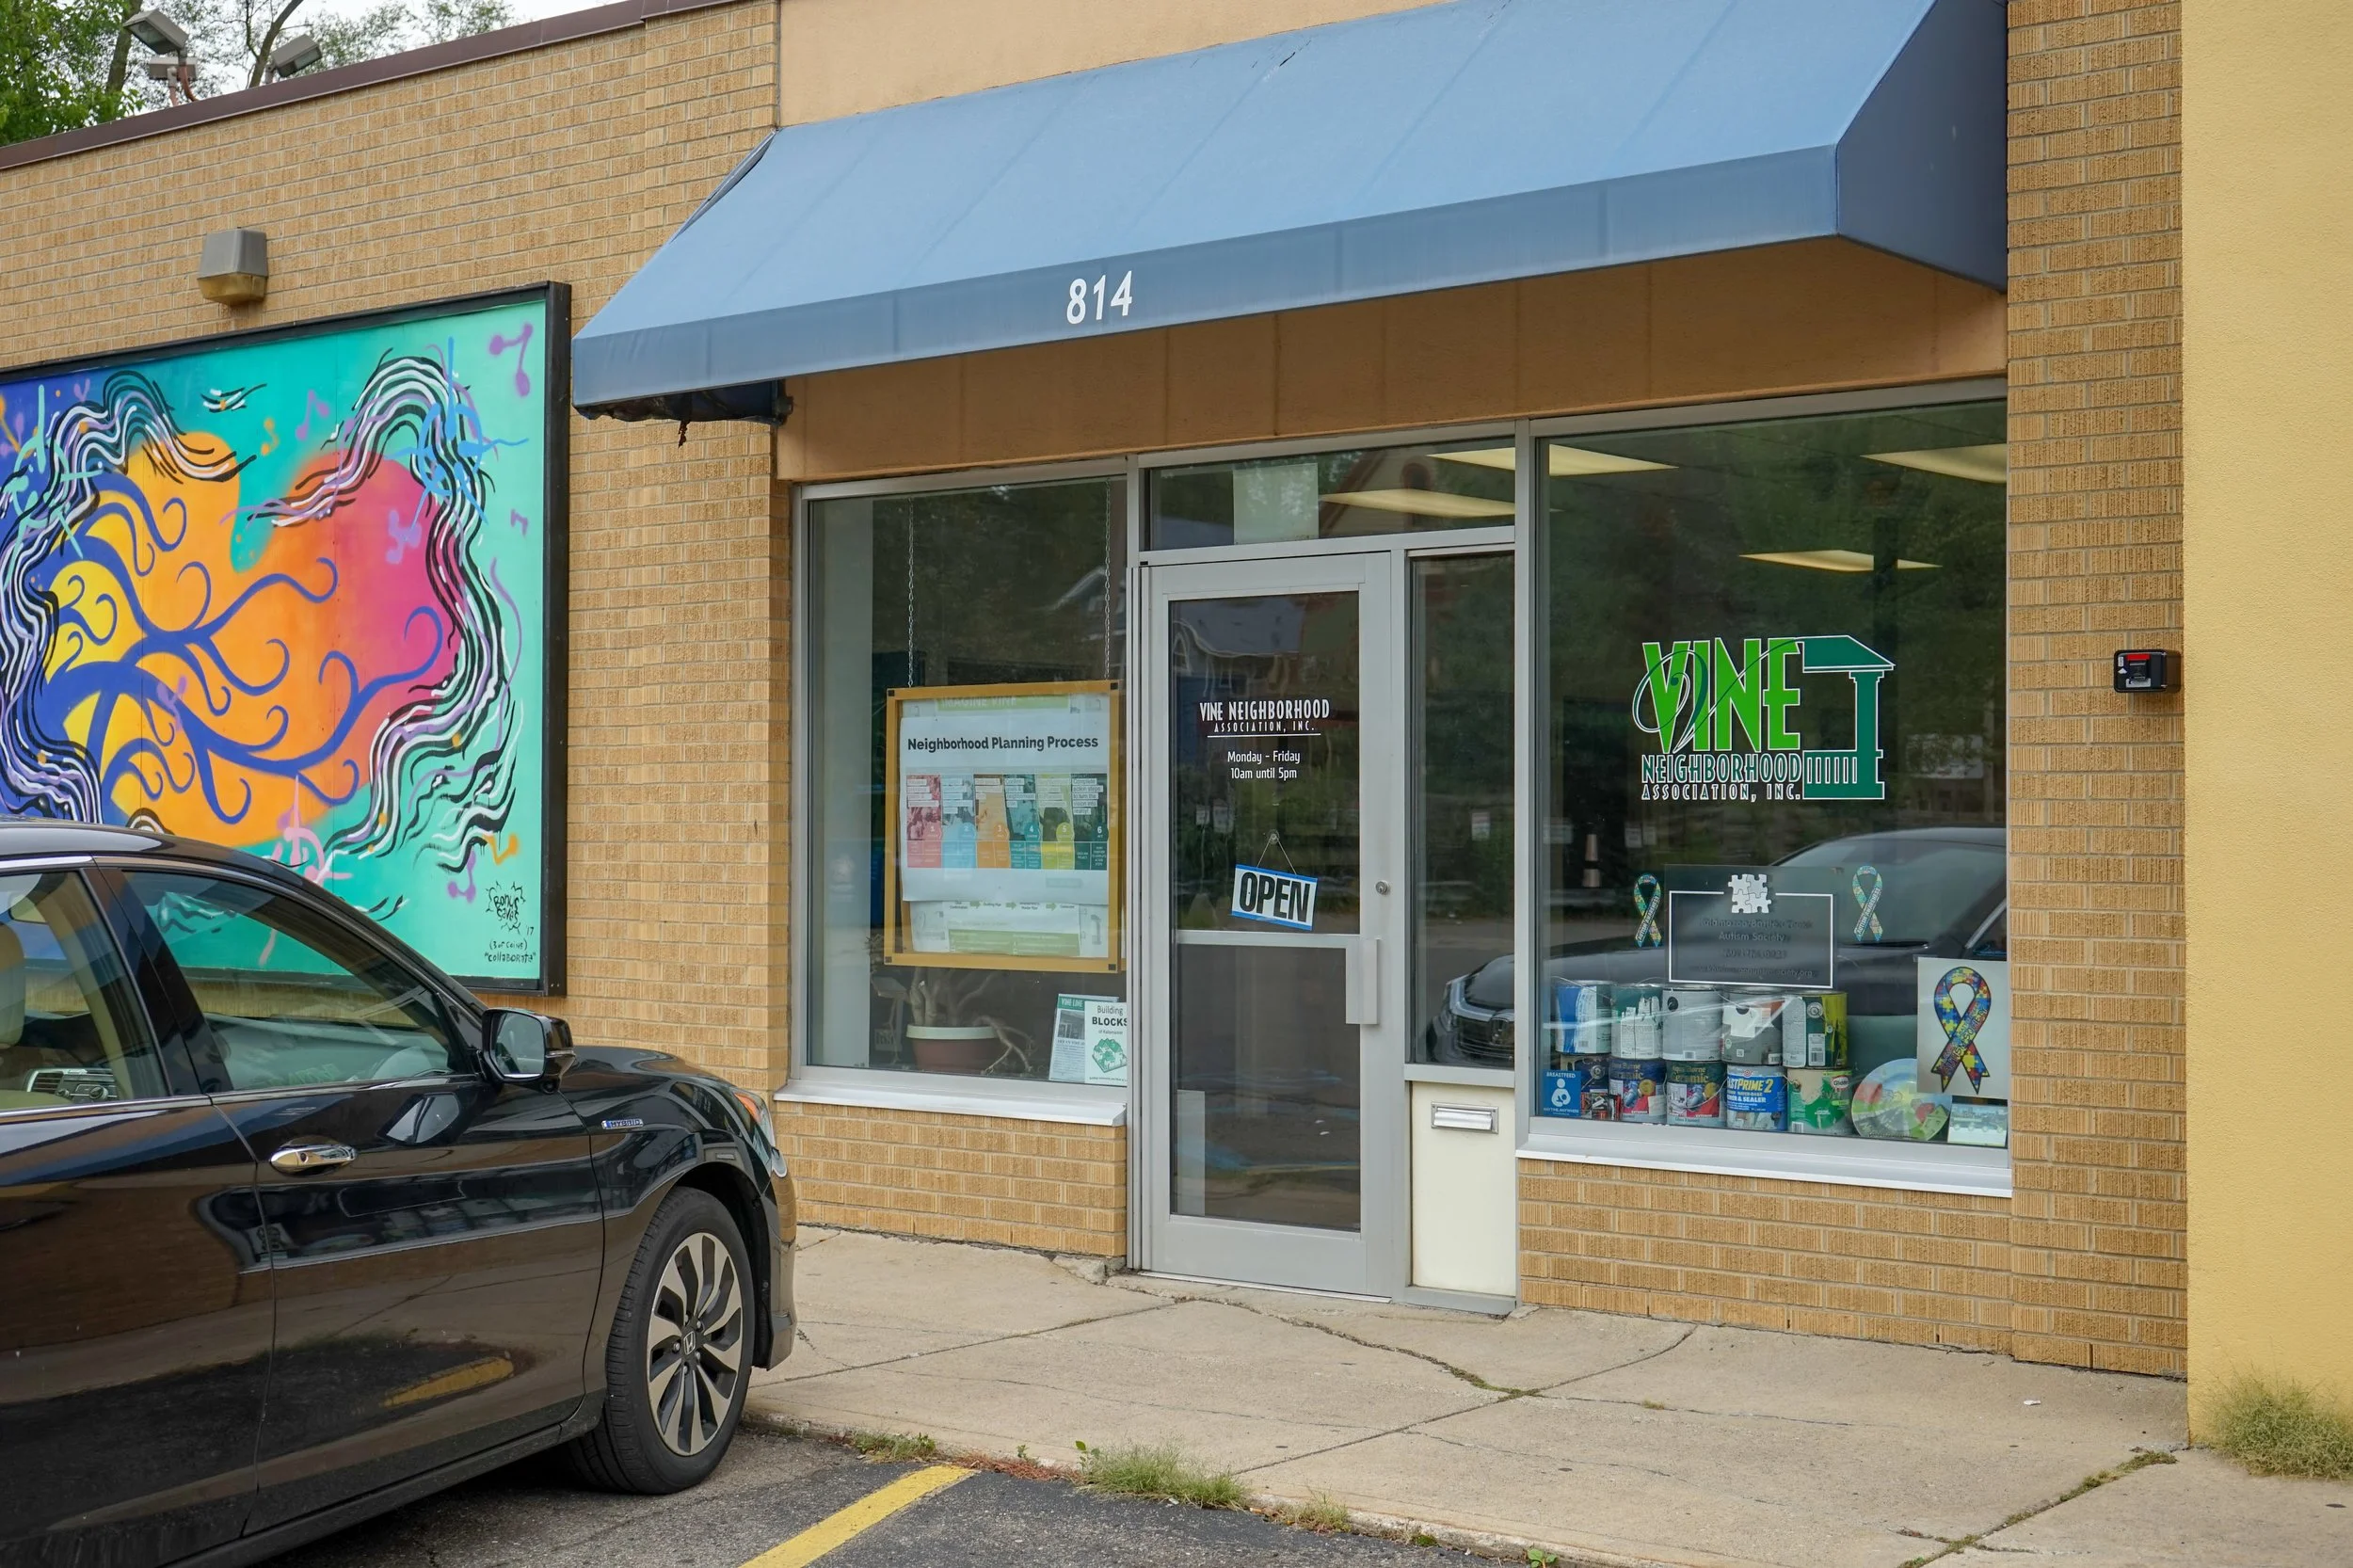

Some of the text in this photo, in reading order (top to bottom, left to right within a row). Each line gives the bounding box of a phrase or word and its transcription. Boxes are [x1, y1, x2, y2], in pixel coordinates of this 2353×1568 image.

[1066, 270, 1132, 325] 814
[1642, 637, 1802, 754] VINE
[1199, 699, 1330, 722] VINE NEIGHBORHOOD
[1214, 722, 1315, 733] ASSOCIATION, INC.
[907, 735, 1099, 753] Neighborhood Planning Process
[1227, 751, 1262, 765] Monday
[1273, 750, 1301, 764] Friday
[1231, 767, 1297, 781] 10am until 5pm
[1641, 753, 1802, 783] NEIGHBORHOOD
[1641, 783, 1801, 803] ASSOCIATION, INC.
[1239, 871, 1311, 923] OPEN
[1096, 1004, 1124, 1016] Building
[1763, 1078, 1774, 1094] 2
[610, 1119, 641, 1128] HYBRID
